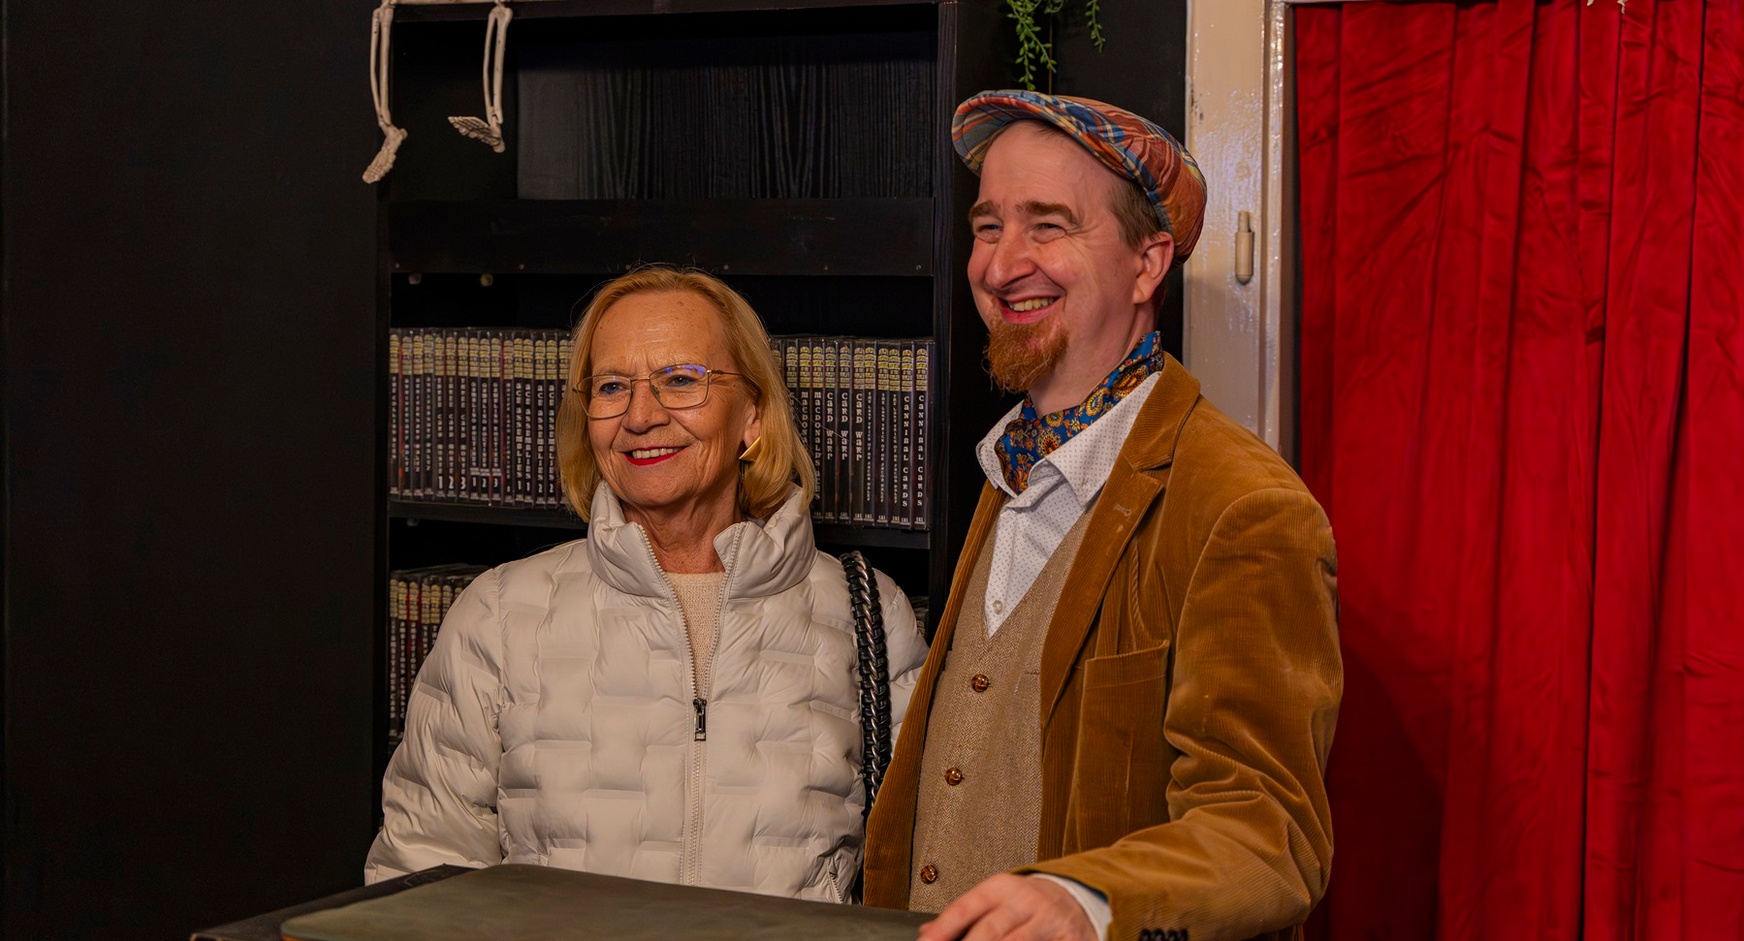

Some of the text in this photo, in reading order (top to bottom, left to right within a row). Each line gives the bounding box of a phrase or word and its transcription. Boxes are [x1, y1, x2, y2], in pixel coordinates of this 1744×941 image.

[437, 475, 443, 490] 1
[448, 475, 454, 490] 2
[460, 475, 466, 490] 3
